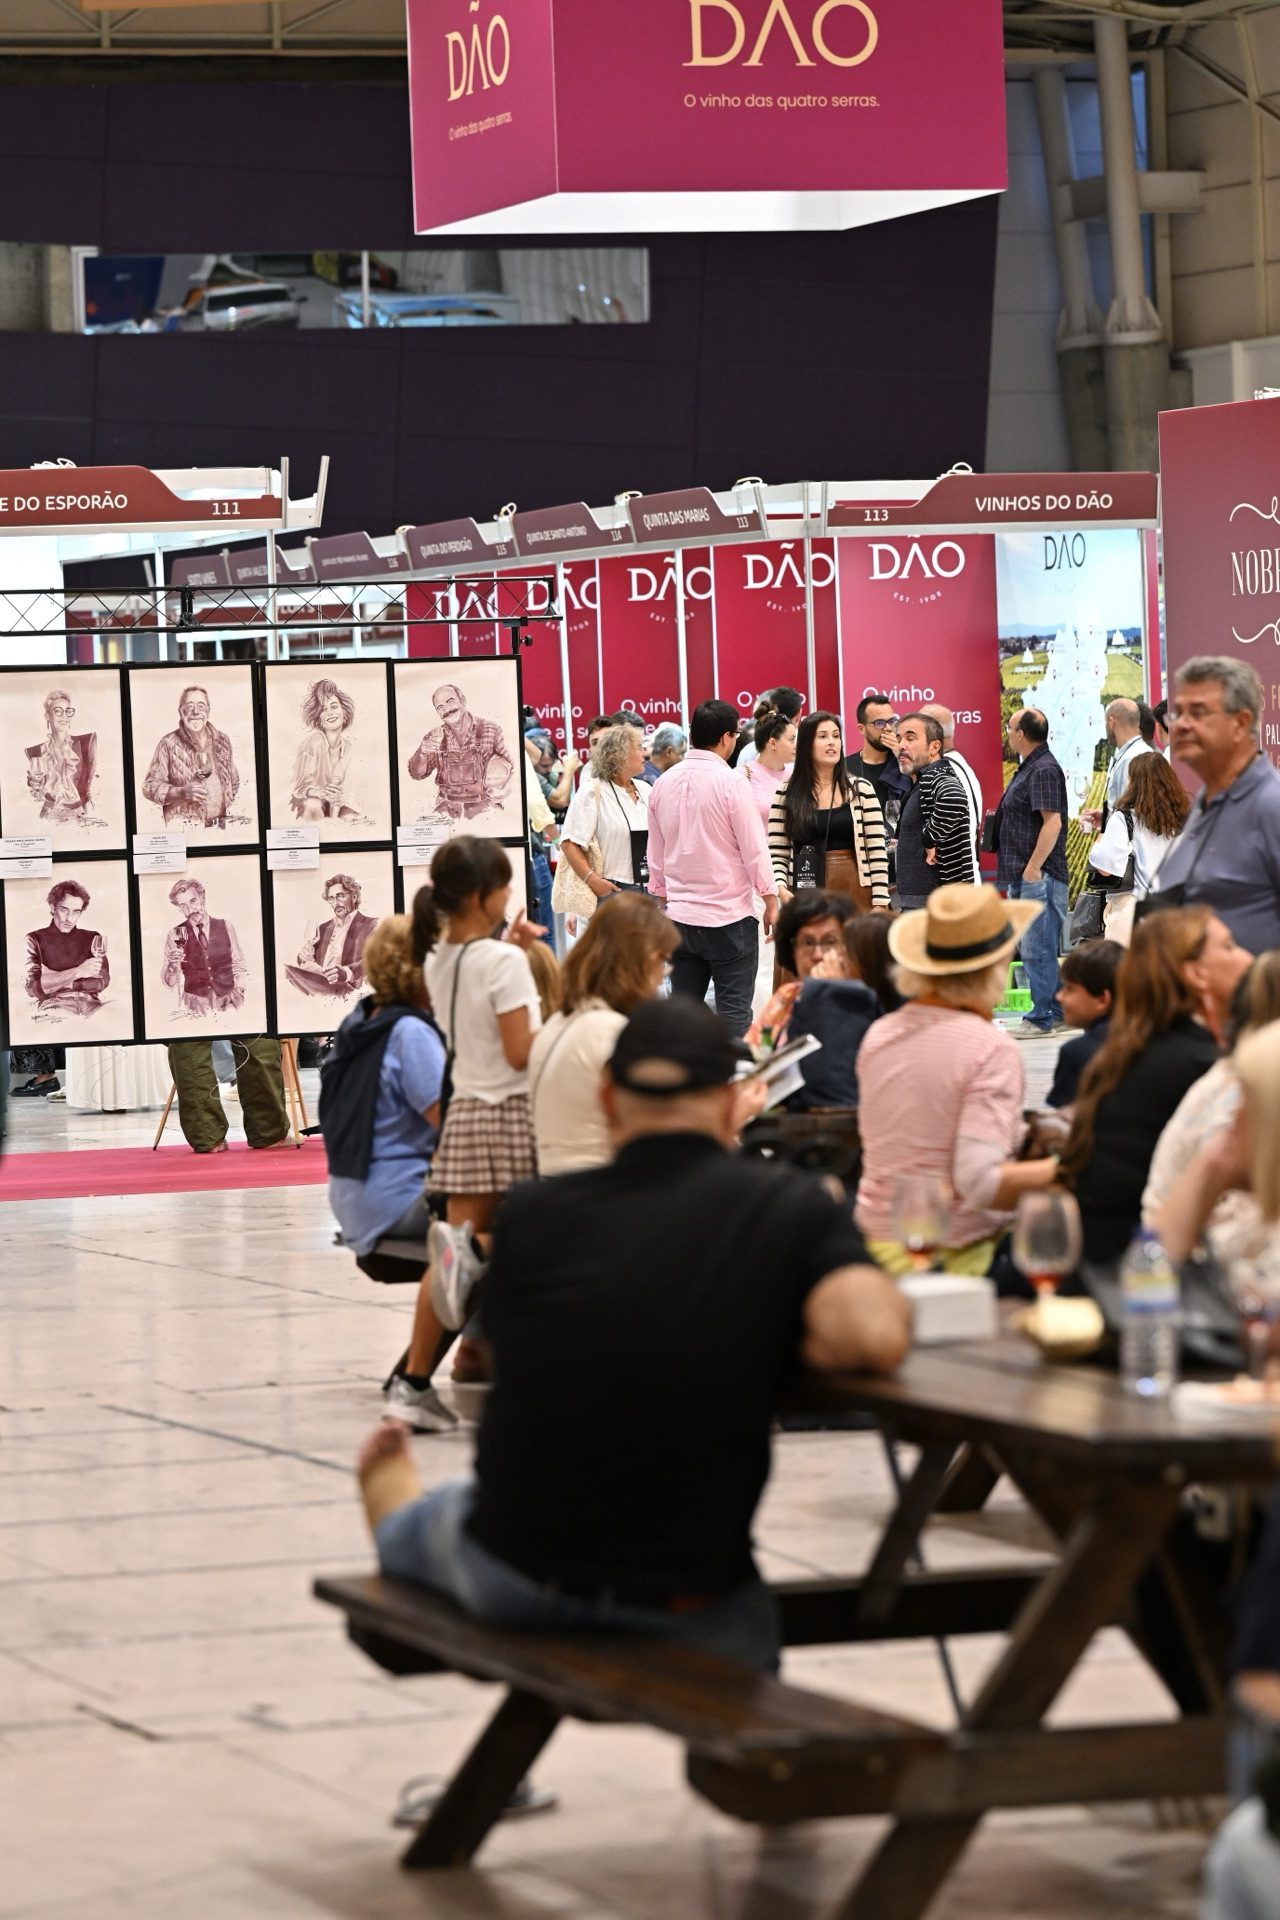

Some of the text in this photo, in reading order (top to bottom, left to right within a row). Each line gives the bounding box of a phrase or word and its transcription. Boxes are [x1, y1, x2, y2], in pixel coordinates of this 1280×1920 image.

[684, 93, 880, 111] O vinho das quatro serras.
[14, 497, 40, 511] DO
[45, 491, 128, 510] ESPORÃO
[212, 502, 240, 515] 111
[975, 490, 1113, 512] VINHOS DO DÃO
[643, 508, 710, 531] QUINTA DAS MARIAS
[736, 517, 749, 528] 113
[864, 510, 889, 521] 113
[742, 542, 836, 589] DÃO
[868, 532, 966, 580] DÃO
[627, 557, 712, 601] DÃO
